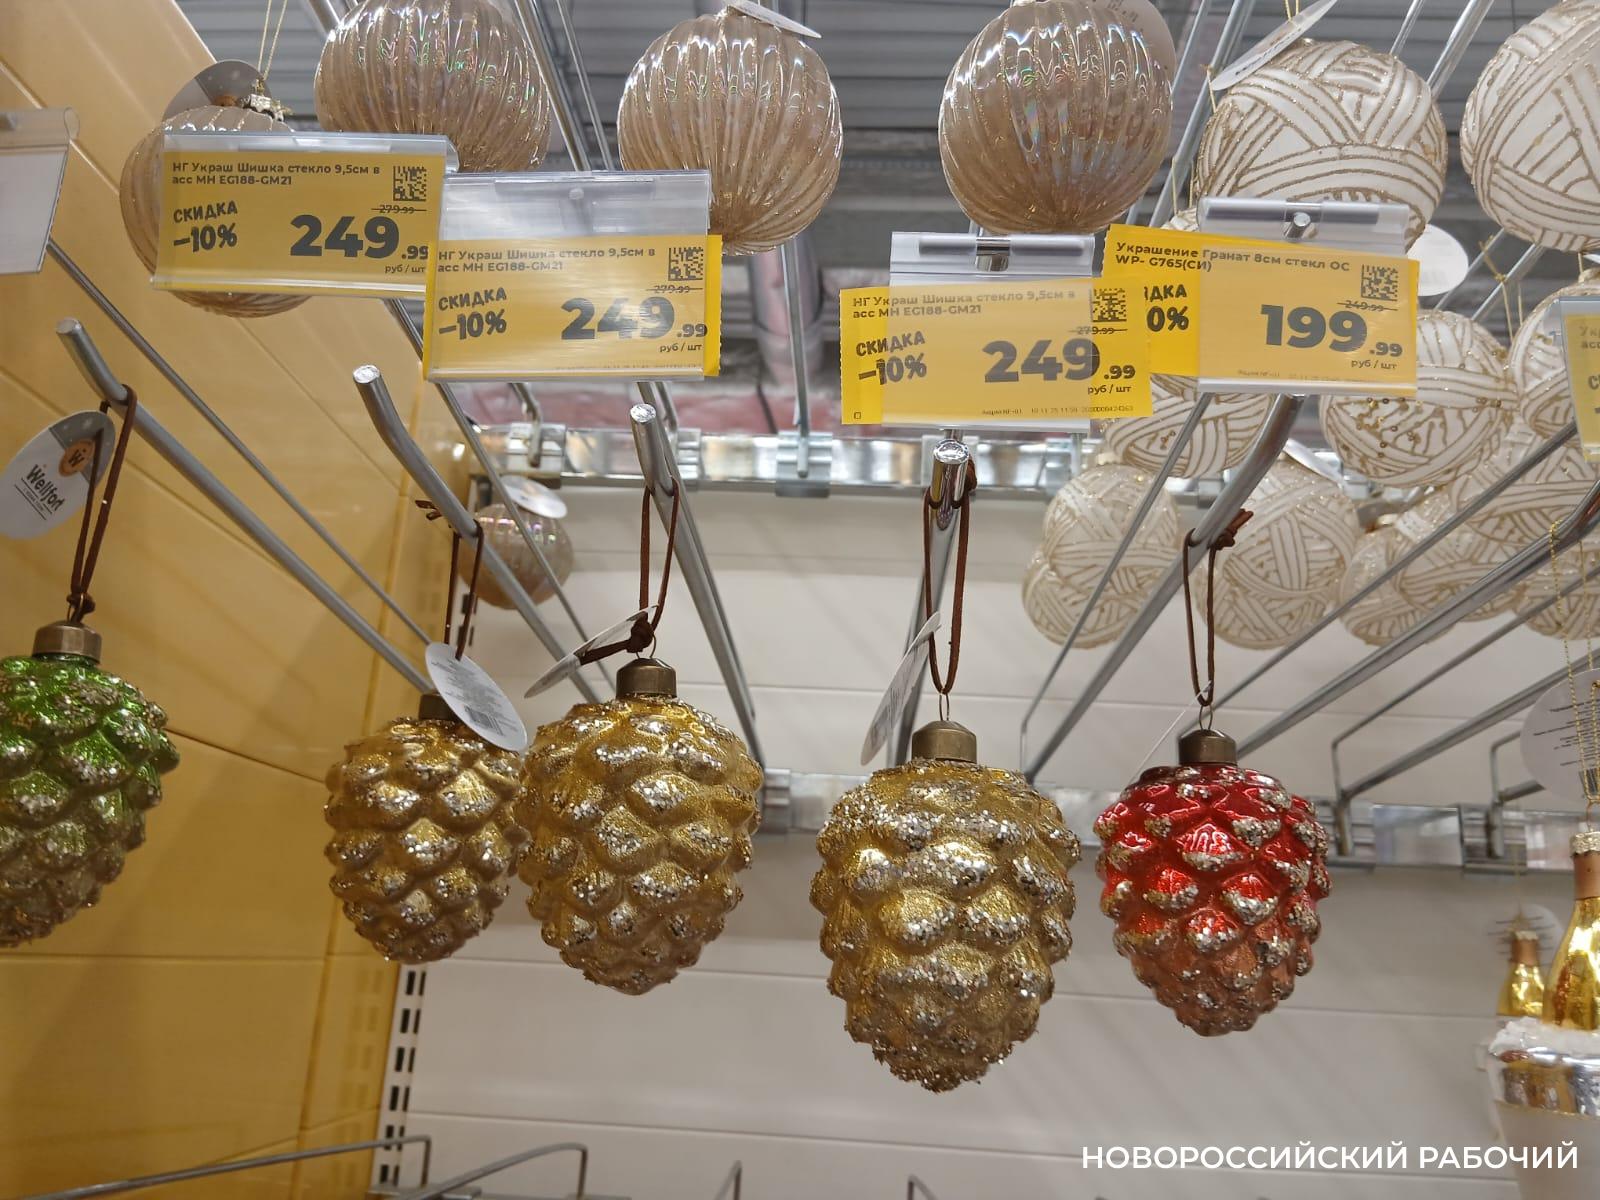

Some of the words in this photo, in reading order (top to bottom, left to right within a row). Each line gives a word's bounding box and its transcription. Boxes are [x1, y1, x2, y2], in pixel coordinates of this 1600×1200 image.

[173, 162, 188, 172] НГ
[192, 163, 233, 174] Украш
[237, 163, 283, 173] Шишка
[288, 165, 331, 174] стекло
[335, 165, 369, 175] 9,5см
[172, 176, 192, 185] асс
[196, 175, 216, 184] МН
[173, 200, 238, 223] СКИДКА
[290, 214, 400, 259] 249
[438, 251, 455, 260] НГ
[459, 250, 502, 261] Украш
[507, 249, 555, 259] Шишка
[559, 248, 604, 258] стекло
[608, 247, 644, 258] 9,5см
[1116, 242, 1199, 258] Украшение
[1203, 250, 1250, 262] Гранат
[1254, 253, 1281, 265] 8см
[1285, 257, 1326, 269] стекл
[1330, 260, 1350, 271] ОС
[1116, 255, 1145, 265] WP-
[385, 264, 403, 274] руб
[412, 265, 426, 273] шт
[438, 287, 507, 311] СКИДКА
[853, 297, 870, 307] НГ
[873, 296, 918, 307] Украш
[922, 294, 972, 304] Шишка
[976, 292, 1023, 302] стекло
[1027, 290, 1063, 301] 9,5см
[561, 296, 675, 340] 249
[1146, 305, 1189, 332] 0%
[1261, 304, 1367, 352] 199
[660, 343, 679, 353] руб
[687, 343, 702, 351] шт
[855, 331, 925, 357] СКИДКА
[982, 338, 1100, 383] 249
[1351, 359, 1371, 370] руб
[1381, 361, 1397, 369] шт
[1088, 384, 1107, 395] руб
